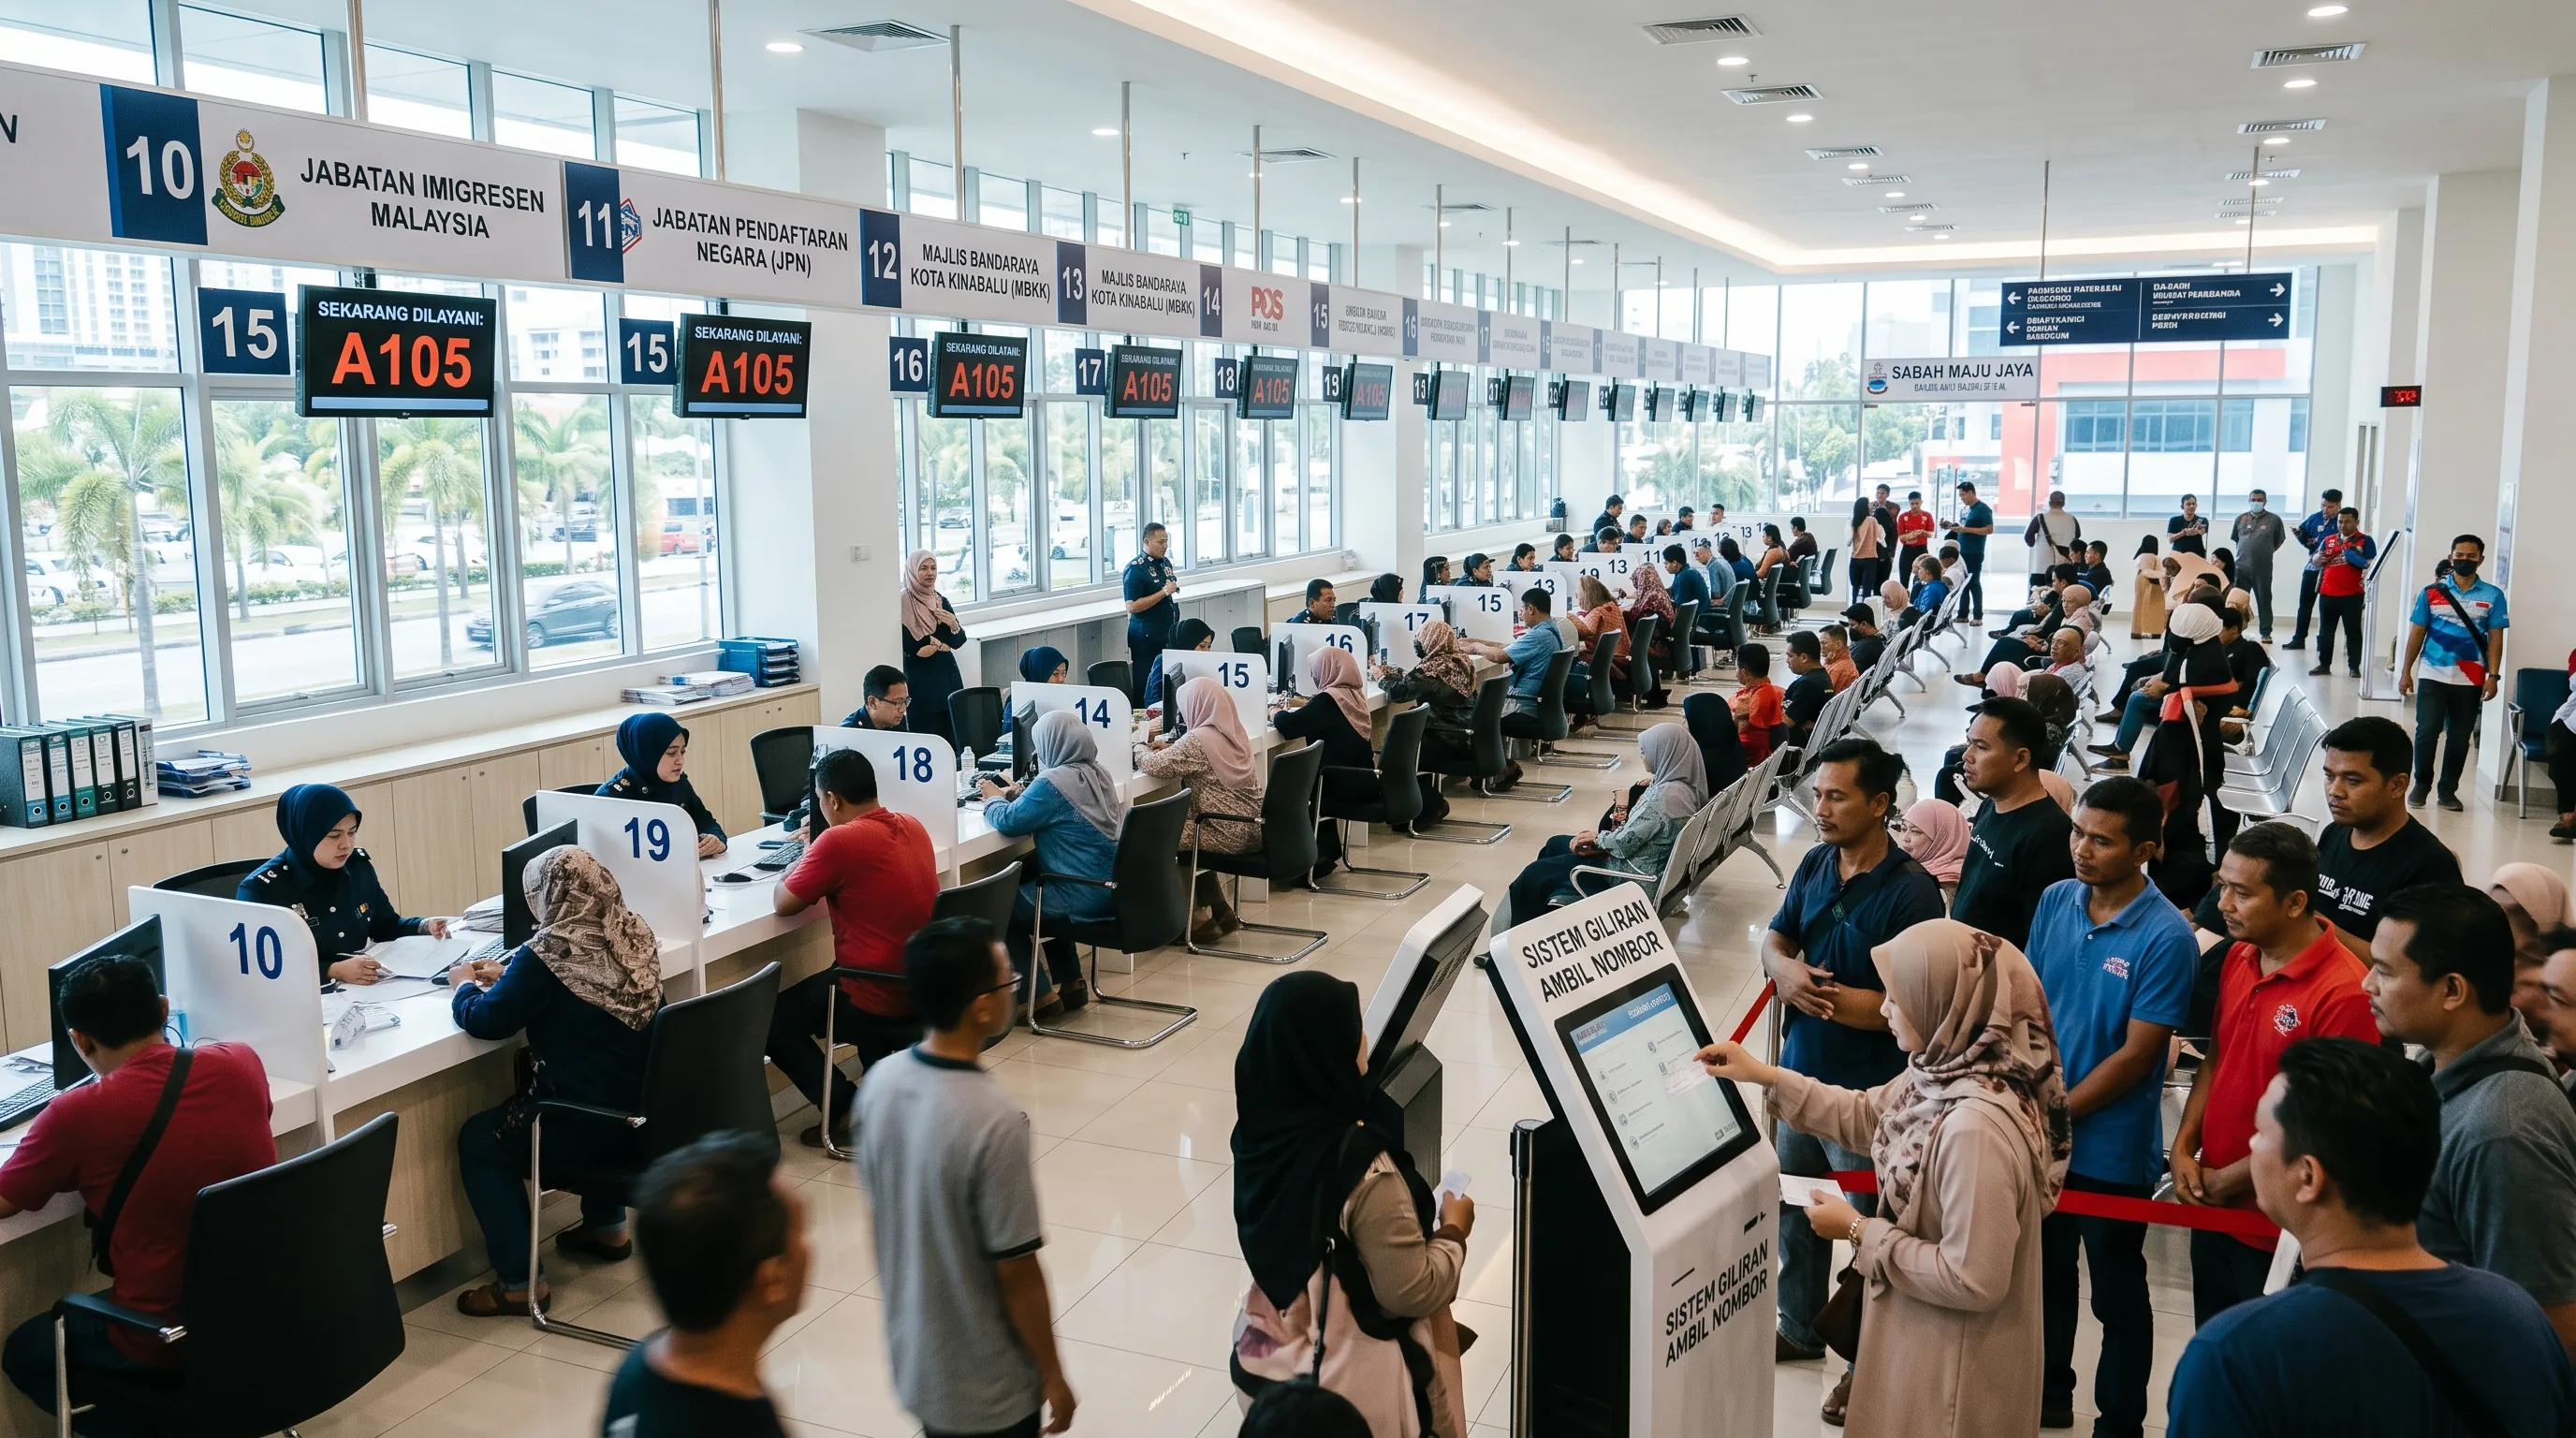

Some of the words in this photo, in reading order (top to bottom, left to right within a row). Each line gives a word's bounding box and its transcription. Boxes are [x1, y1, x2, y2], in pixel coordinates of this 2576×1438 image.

[127, 136, 195, 199] 10
[300, 157, 416, 197] JABATAN
[422, 173, 544, 213] IMIGRESEN
[371, 201, 490, 239] MALAYSIA
[578, 199, 613, 250] 11
[652, 207, 730, 236] JABATAN
[736, 219, 848, 251] PENDAFTARAN
[696, 242, 768, 269] NEGARA
[771, 252, 812, 278] (JPN)
[869, 240, 898, 280] 12
[923, 243, 967, 266] MAJLIS
[970, 250, 1039, 276] BANDARAYA
[911, 268, 945, 288] KOTA
[949, 271, 1008, 295] KINABALU
[1011, 279, 1051, 303] (MBKK)
[1062, 266, 1084, 301] 13
[1102, 270, 1134, 287] MAJLIS
[1136, 274, 1187, 295] BANDARAYA
[317, 301, 408, 322] SEKARANG
[413, 307, 485, 327] DILAYANI:
[1091, 289, 1117, 306] KOTA
[1120, 292, 1164, 311] KINABALU
[1165, 298, 1195, 318] (MBKK)
[1203, 286, 1221, 316] 14
[1251, 286, 1284, 321] POS
[1313, 302, 1328, 330] 15
[212, 306, 278, 360] 15
[695, 326, 754, 342] SEKARANG
[755, 330, 803, 345] DILAYANI:
[1405, 315, 1417, 339] 16
[1480, 327, 1489, 347] 17
[331, 331, 472, 389] A105
[626, 331, 668, 374] 15
[945, 342, 987, 355] SEKARANG
[700, 350, 795, 396] A105
[893, 347, 923, 383] 16
[949, 361, 1015, 399] A105
[1078, 358, 1102, 387] 17
[1218, 365, 1235, 391] 18
[1892, 365, 1944, 380] SABAH
[1948, 363, 1991, 379] MAJU
[1995, 363, 2034, 377] JAYA
[1123, 371, 1173, 402] A105
[1252, 377, 1290, 404] A105
[1324, 373, 1339, 397] 19
[1741, 526, 1752, 538] 13
[1608, 559, 1628, 574] 13
[1643, 550, 1661, 564] 11
[1477, 594, 1501, 612] 15
[1534, 579, 1555, 595] 13
[1404, 611, 1429, 631] 17
[1325, 633, 1354, 654] 16
[1218, 662, 1251, 689] 15
[1075, 697, 1111, 729] 14
[892, 744, 933, 784] 18
[624, 816, 671, 862] 19
[228, 921, 284, 980] 10
[1522, 925, 1588, 969] SISTEM
[1585, 900, 1650, 943] GILIRAN
[1540, 961, 1595, 1003] AMBIL
[1589, 930, 1664, 978] NOMBOR
[1665, 1280, 1716, 1337] SISTEM
[1719, 1238, 1768, 1297] GILIRAN
[1665, 1316, 1709, 1369] AMBIL
[1712, 1269, 1768, 1331] NOMBOR
